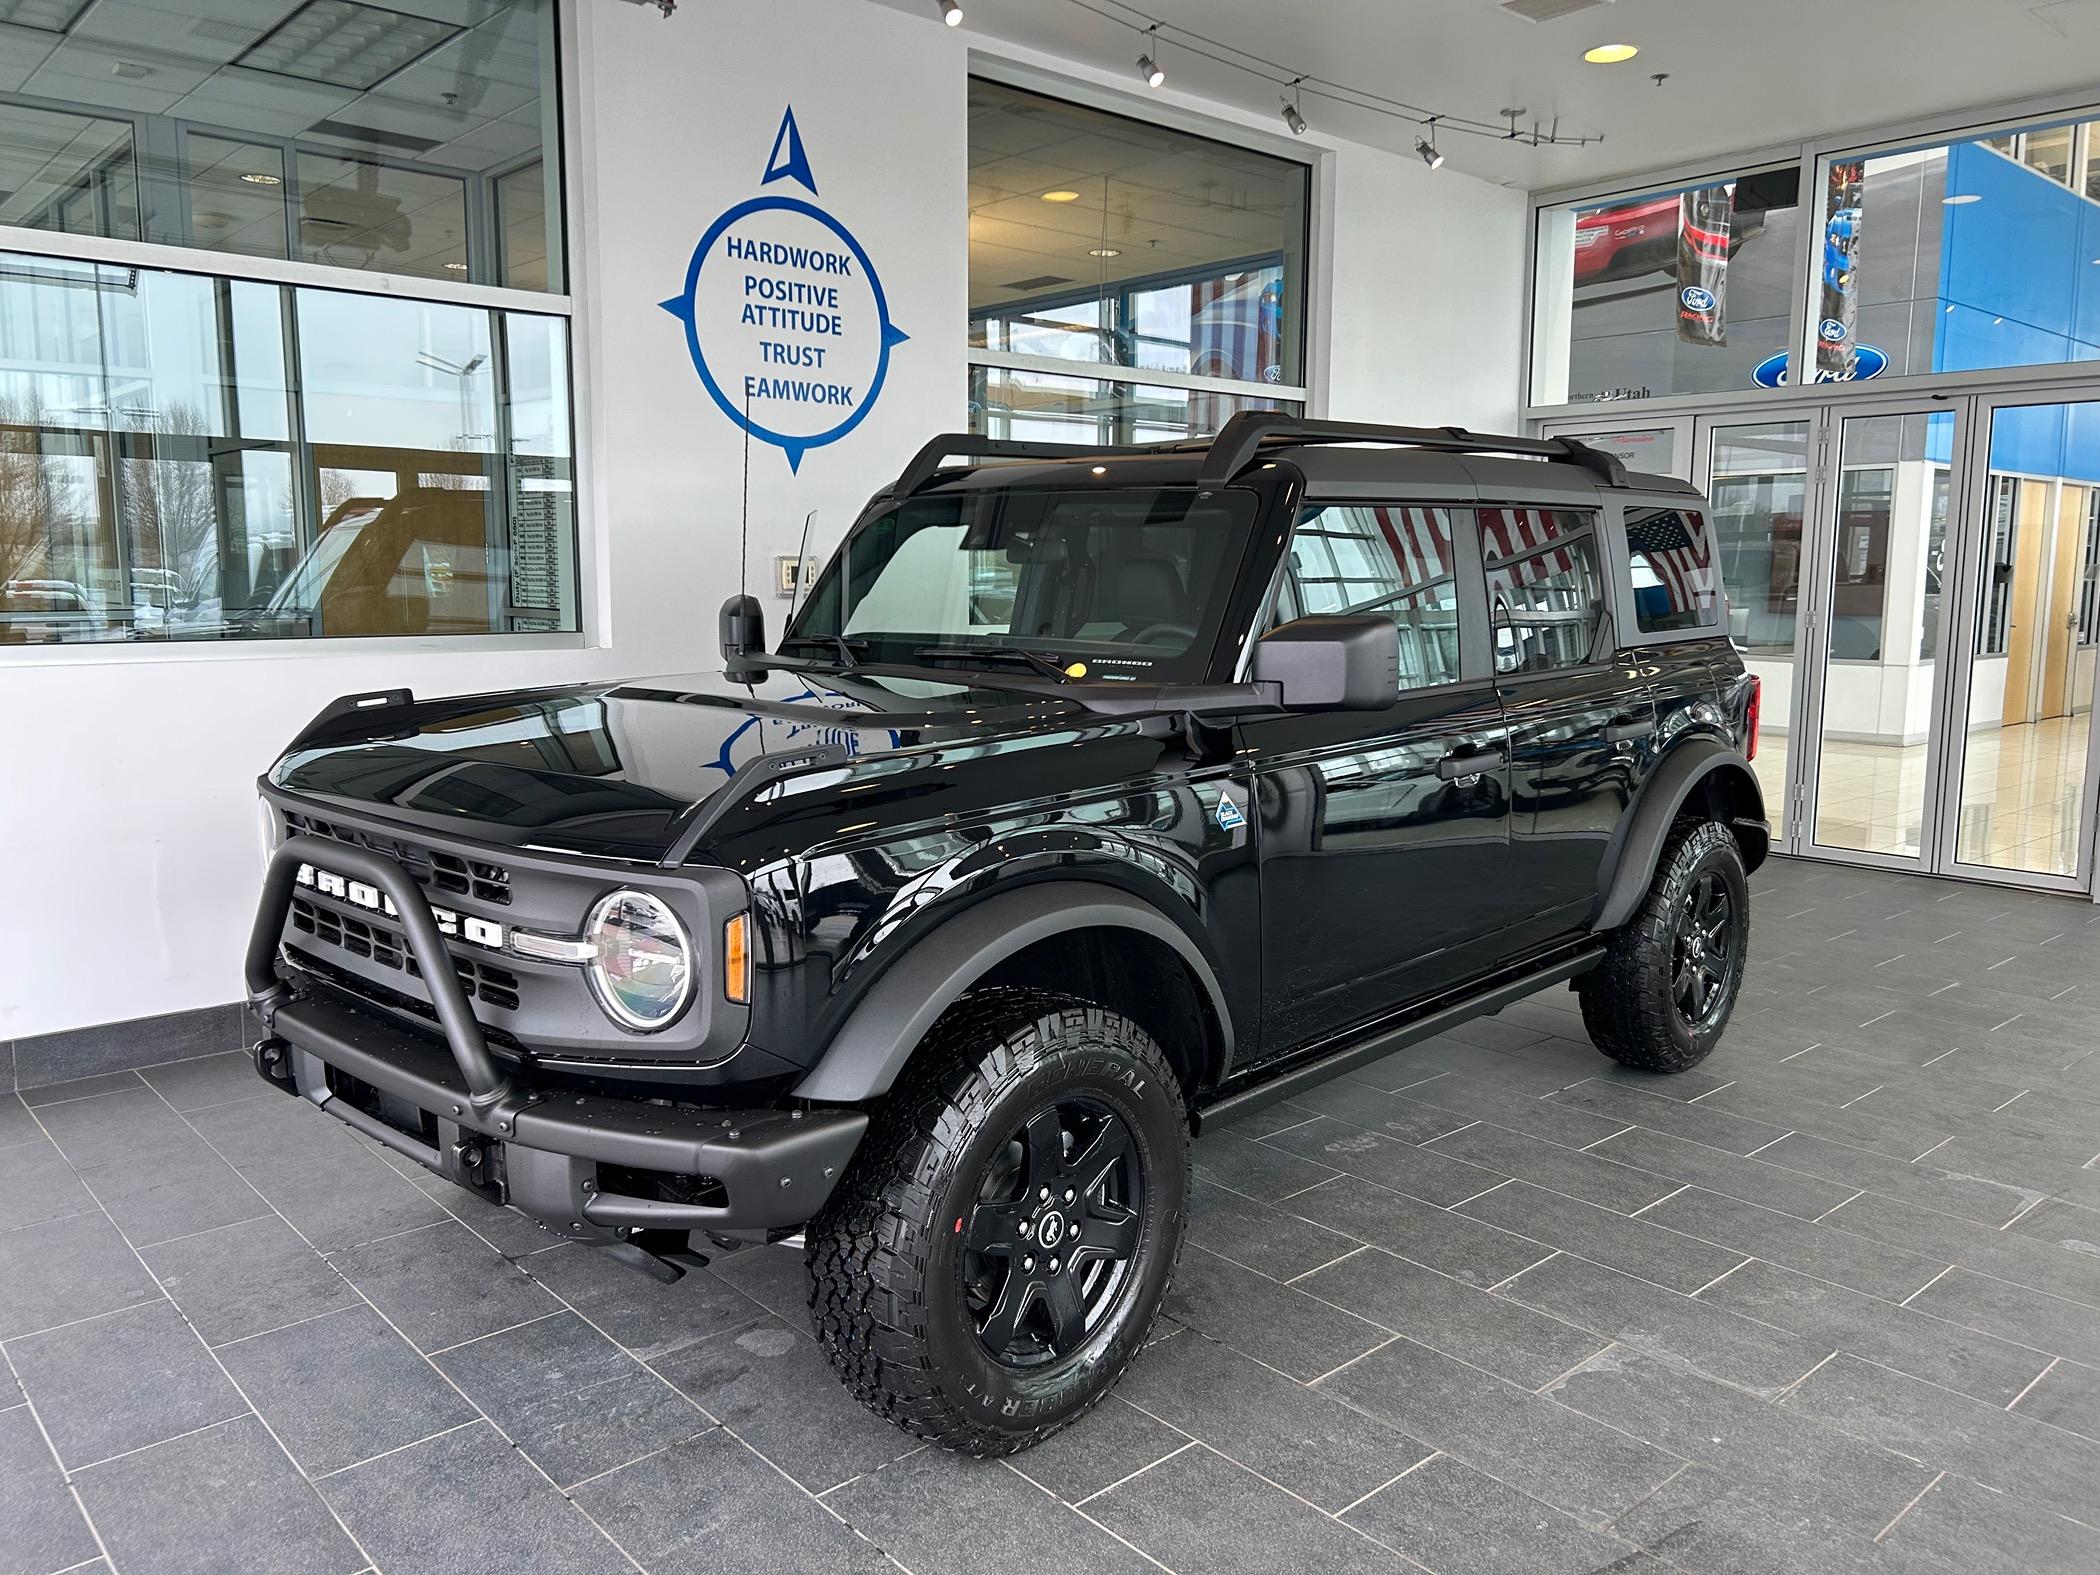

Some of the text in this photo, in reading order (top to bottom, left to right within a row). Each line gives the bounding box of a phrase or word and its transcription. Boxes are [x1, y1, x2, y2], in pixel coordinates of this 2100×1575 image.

[727, 236, 852, 276] HARDWORK
[744, 275, 839, 309] POSITIVE
[1687, 289, 1709, 308] Ford
[741, 304, 842, 336] ATTITUDE
[1680, 311, 1714, 323] RACING
[1824, 321, 1841, 338] Ford
[759, 341, 826, 368] TRUST
[744, 375, 854, 406] EAMWORK
[1568, 392, 1594, 400] orthern
[1092, 658, 1153, 667] BRONCO
[1027, 1058, 1147, 1100] GENERAL
